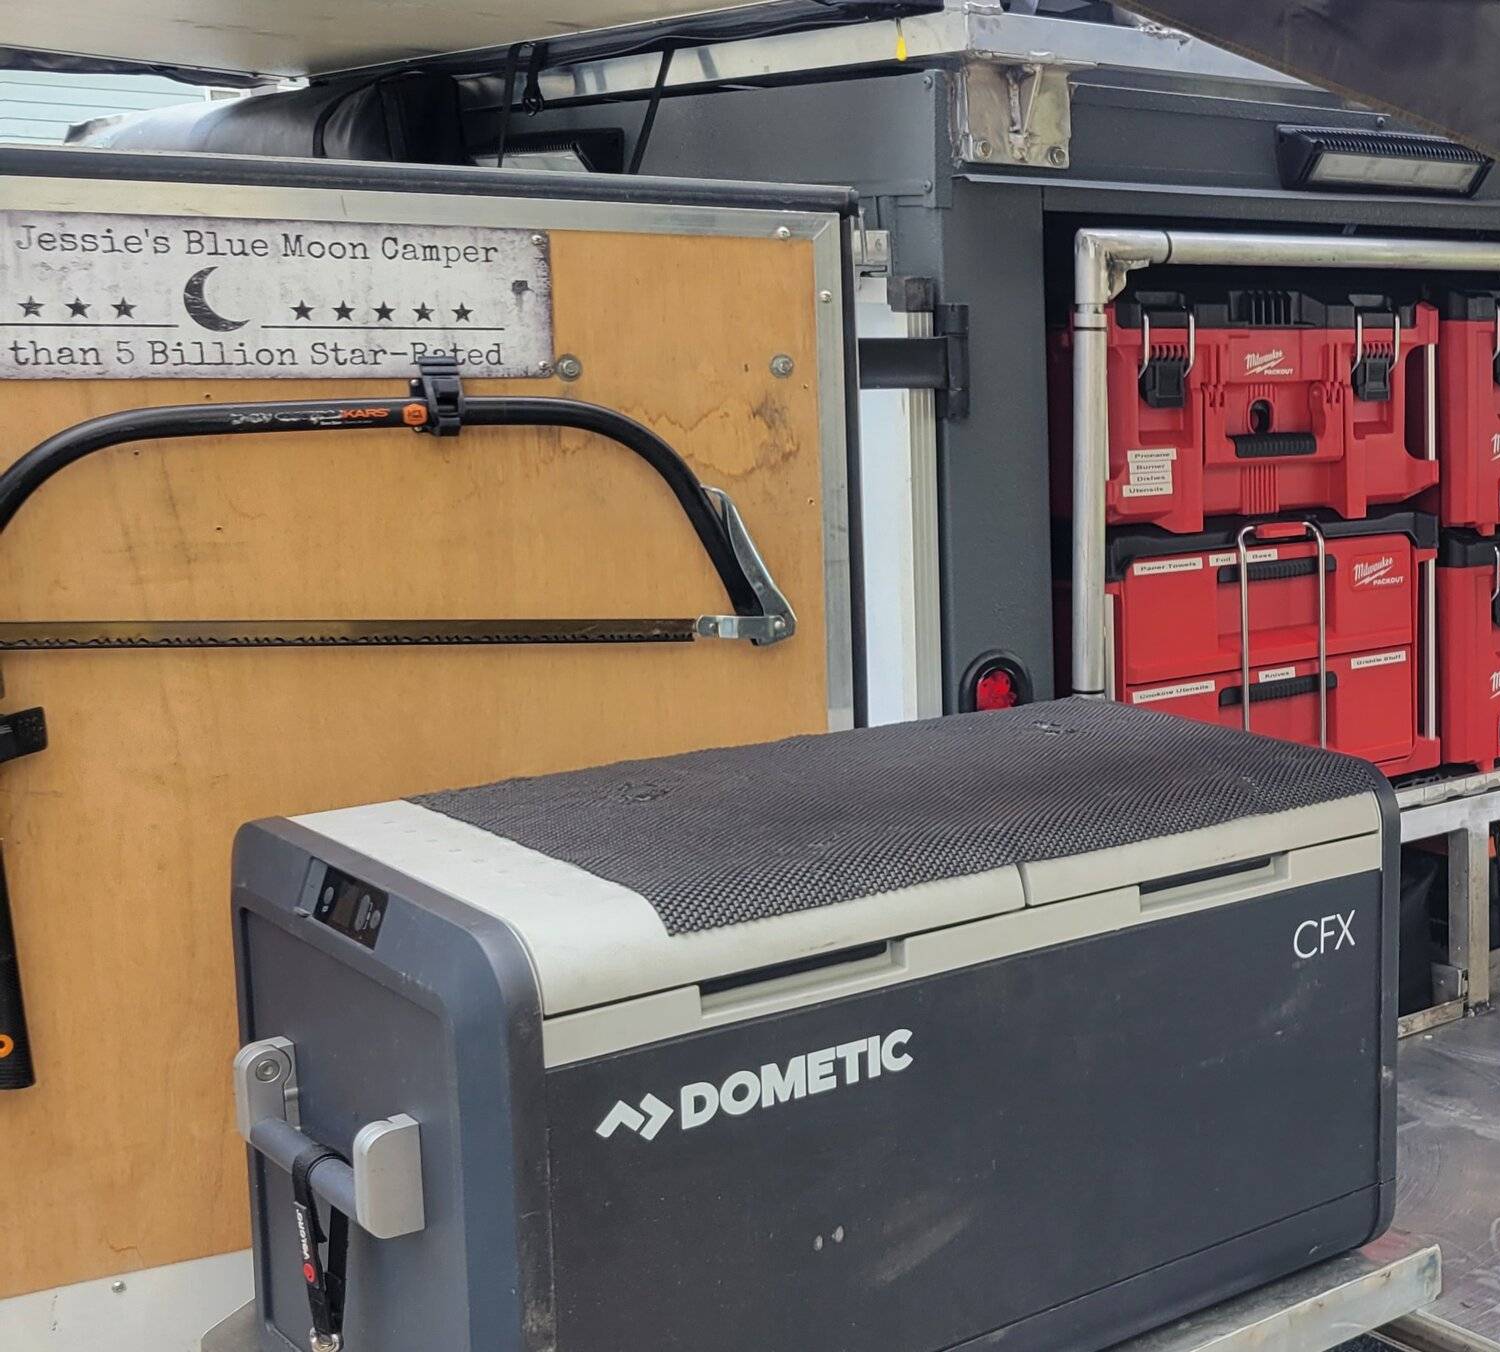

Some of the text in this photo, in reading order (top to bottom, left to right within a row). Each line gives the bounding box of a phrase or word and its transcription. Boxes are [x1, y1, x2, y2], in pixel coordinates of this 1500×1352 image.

[15, 225, 499, 268] Jessie's Blue Moon Camper
[10, 340, 101, 366] than
[116, 340, 135, 366] 5
[146, 340, 299, 367] Billion
[1372, 576, 1403, 586] PACKOUT
[1293, 909, 1356, 959] CFX
[681, 1028, 914, 1130] DOMETIC
